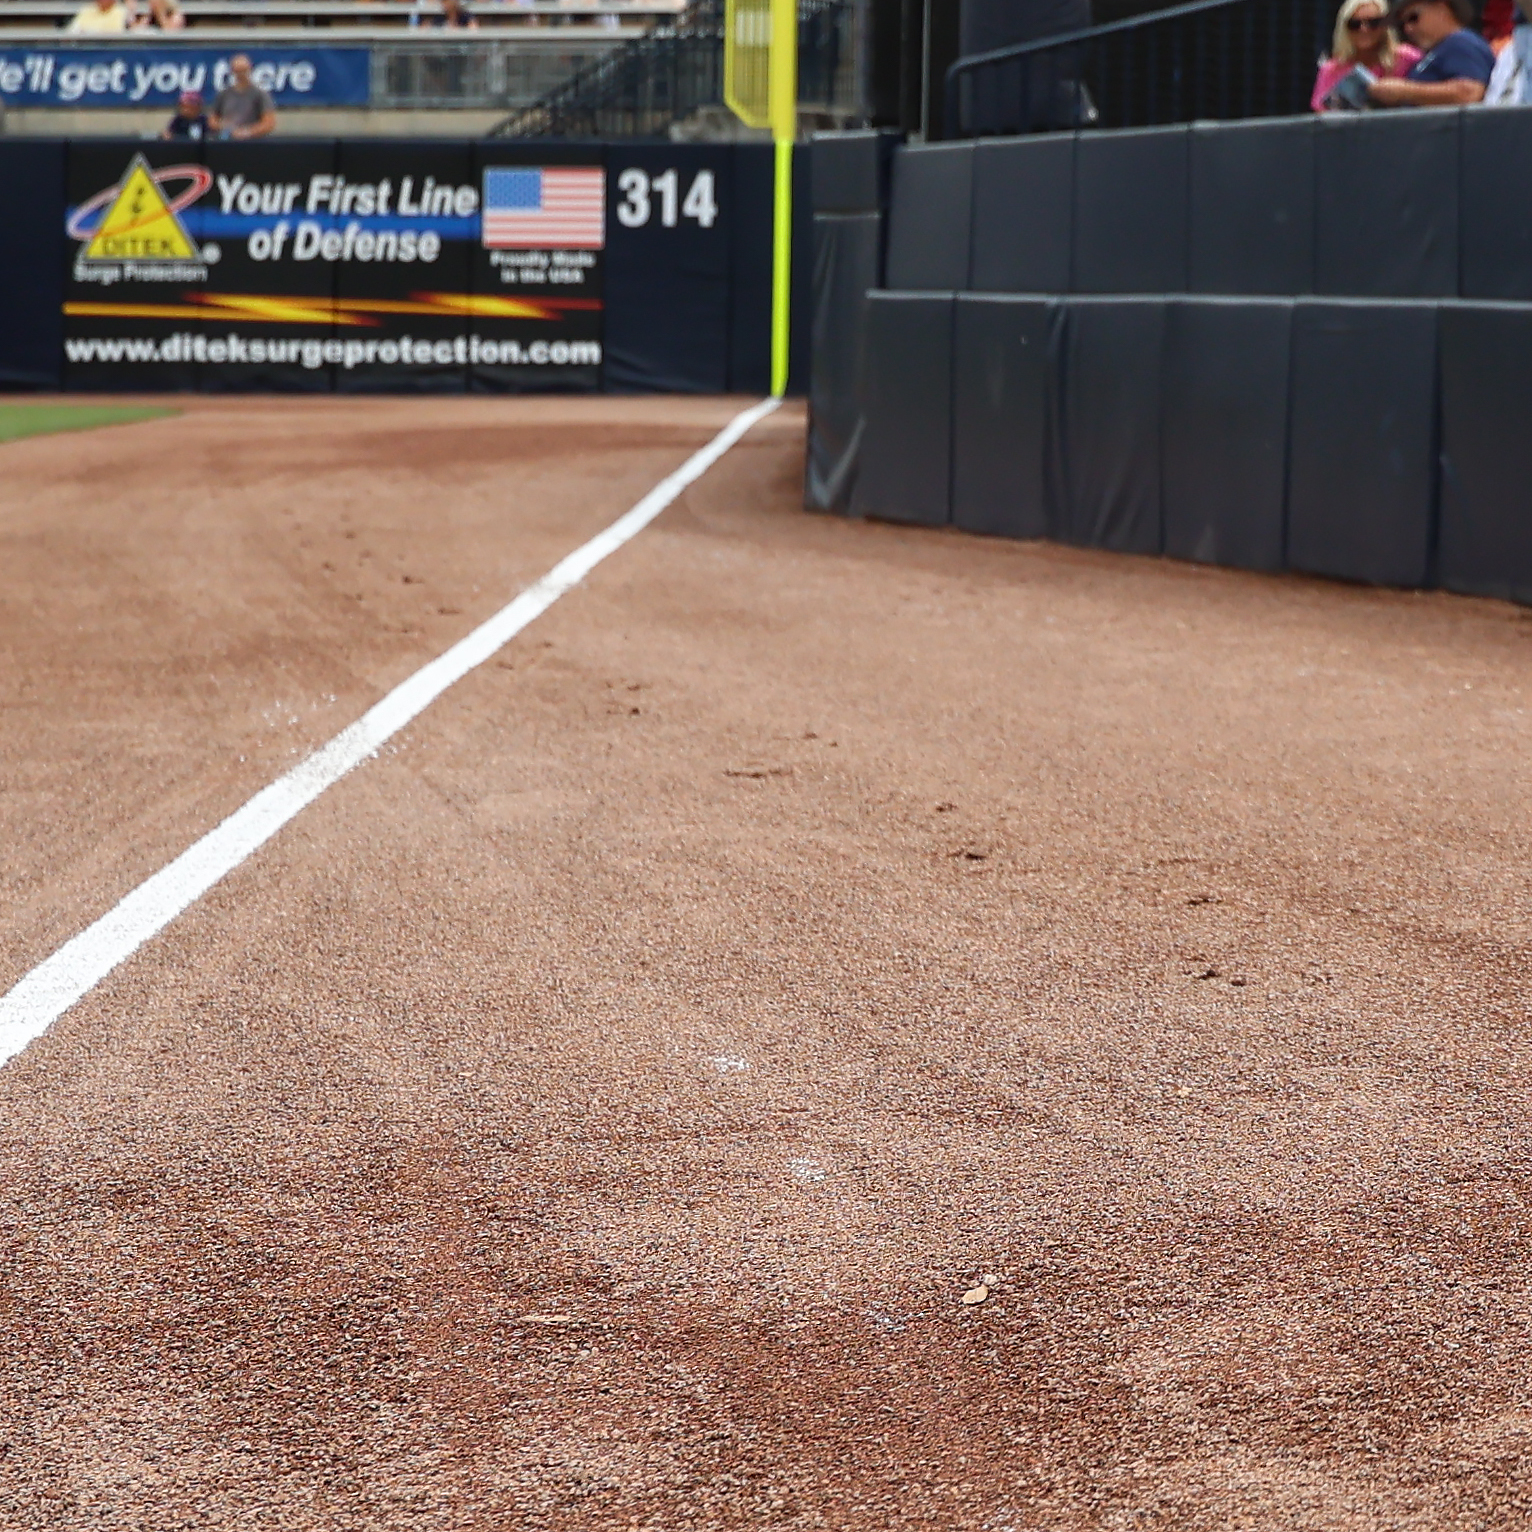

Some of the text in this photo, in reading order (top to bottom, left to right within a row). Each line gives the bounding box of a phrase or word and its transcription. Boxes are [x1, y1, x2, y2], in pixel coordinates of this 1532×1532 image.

[0, 54, 318, 101] e'll get you tere
[216, 173, 480, 217] Your First Line
[616, 168, 719, 228] 314
[248, 220, 442, 263] of Defense
[65, 332, 602, 369] www.diteksurgeprotection.com
